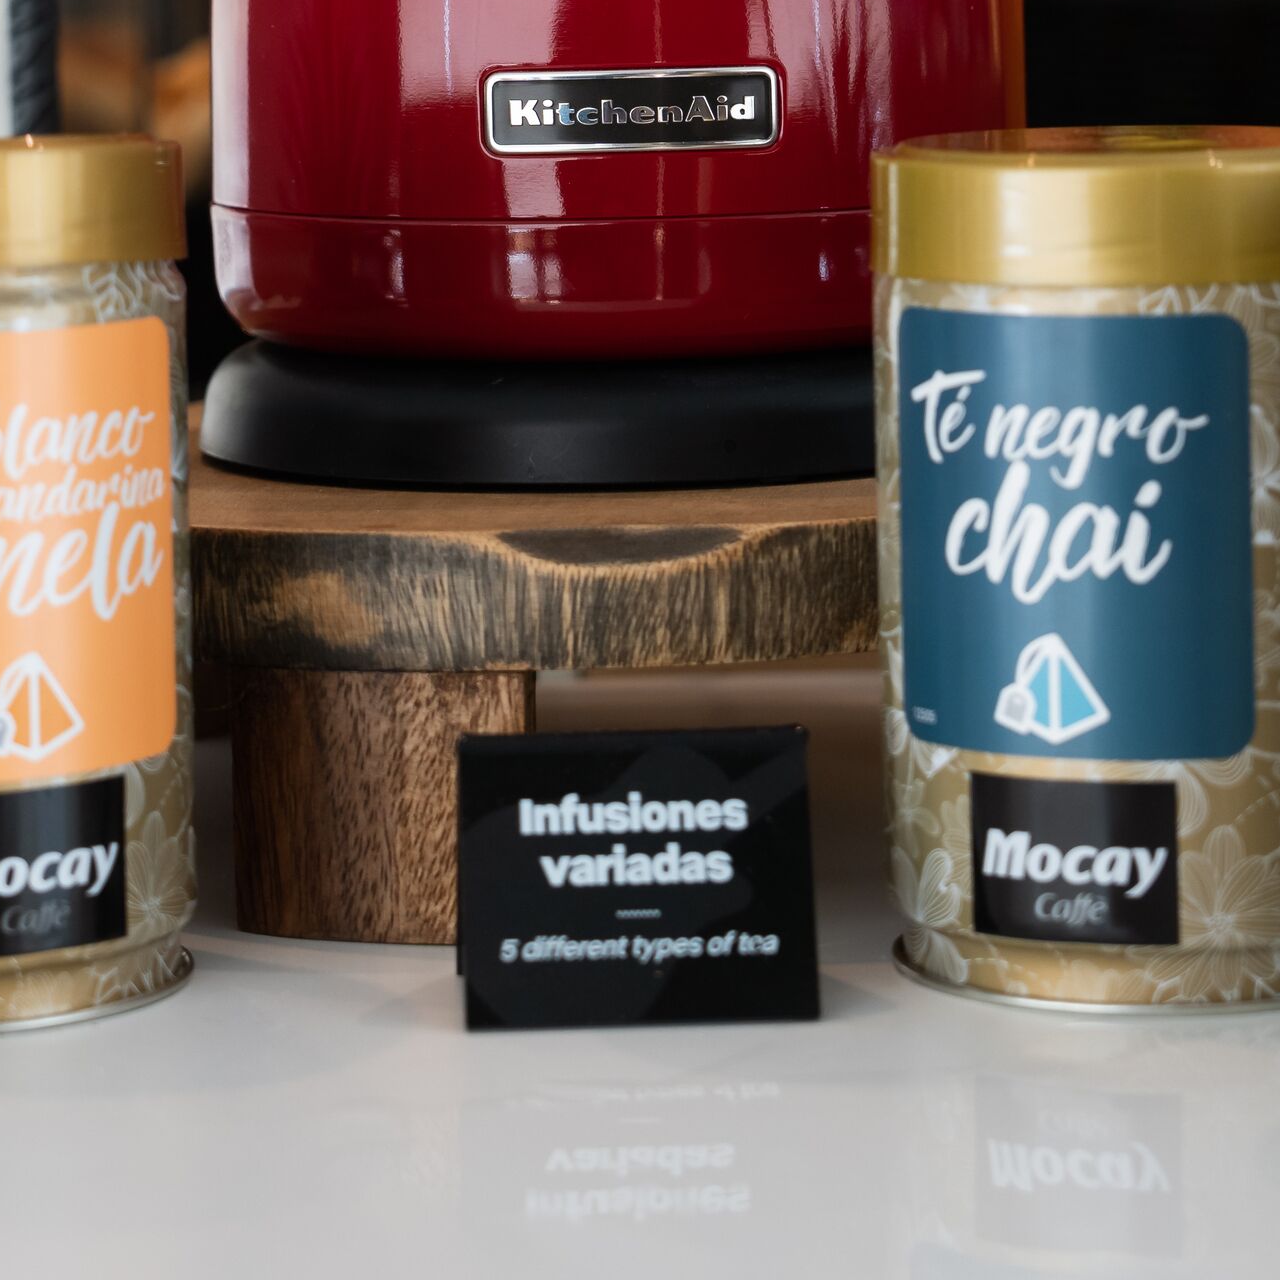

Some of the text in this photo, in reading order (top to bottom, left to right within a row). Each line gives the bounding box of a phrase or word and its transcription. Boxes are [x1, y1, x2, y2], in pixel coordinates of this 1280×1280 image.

[509, 95, 755, 127] KitchenAid
[910, 369, 1210, 490] Té negro
[945, 459, 1172, 605] chai
[519, 790, 748, 836] Infusiones
[539, 841, 734, 888] variadas
[982, 827, 1169, 898] Mocay
[499, 929, 780, 964] 5 different types of tea
